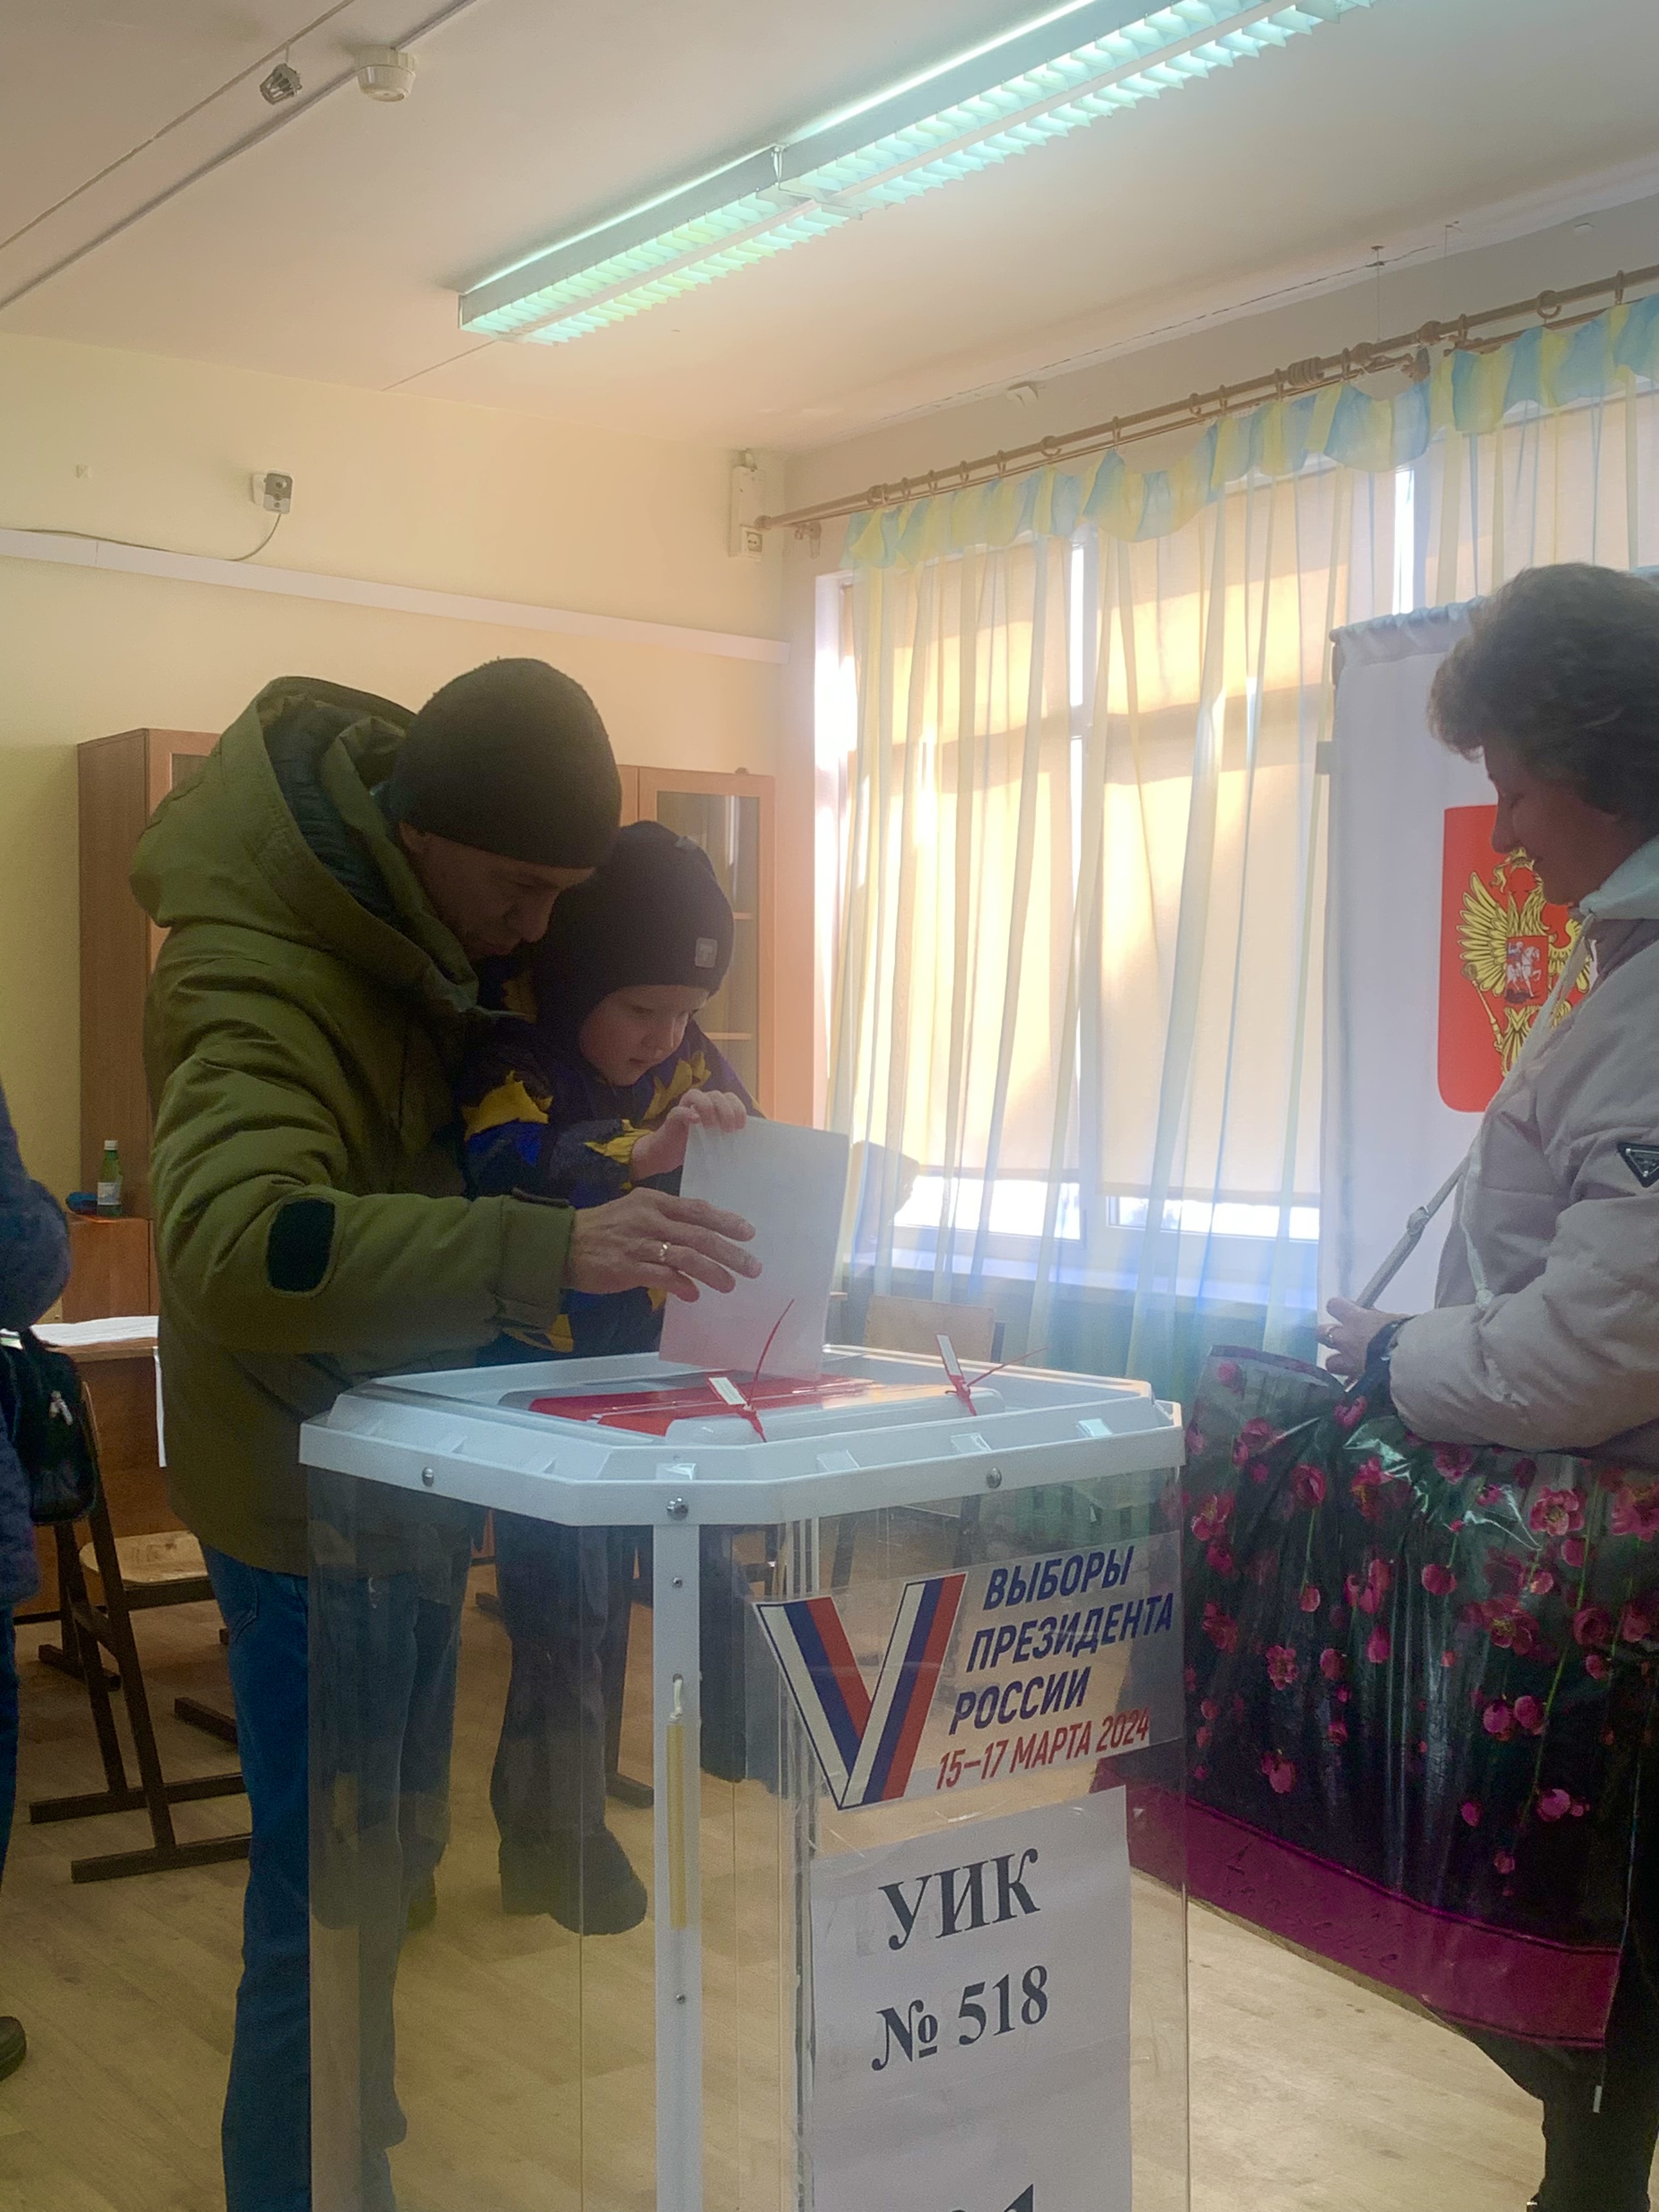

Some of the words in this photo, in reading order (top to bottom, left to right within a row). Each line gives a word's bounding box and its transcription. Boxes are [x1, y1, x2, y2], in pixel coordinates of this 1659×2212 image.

[983, 1546, 1135, 1611] ВЫБОРЫ
[966, 1593, 1174, 1673] ПРЕЗИДЕНТА
[949, 1667, 1092, 1736] РОССИИ
[1011, 1726, 1092, 1774] МАРТА
[1097, 1709, 1152, 1752] 2024
[878, 1848, 1041, 1950] УИК
[871, 1999, 939, 2071] №
[958, 1965, 1048, 2046] 518
